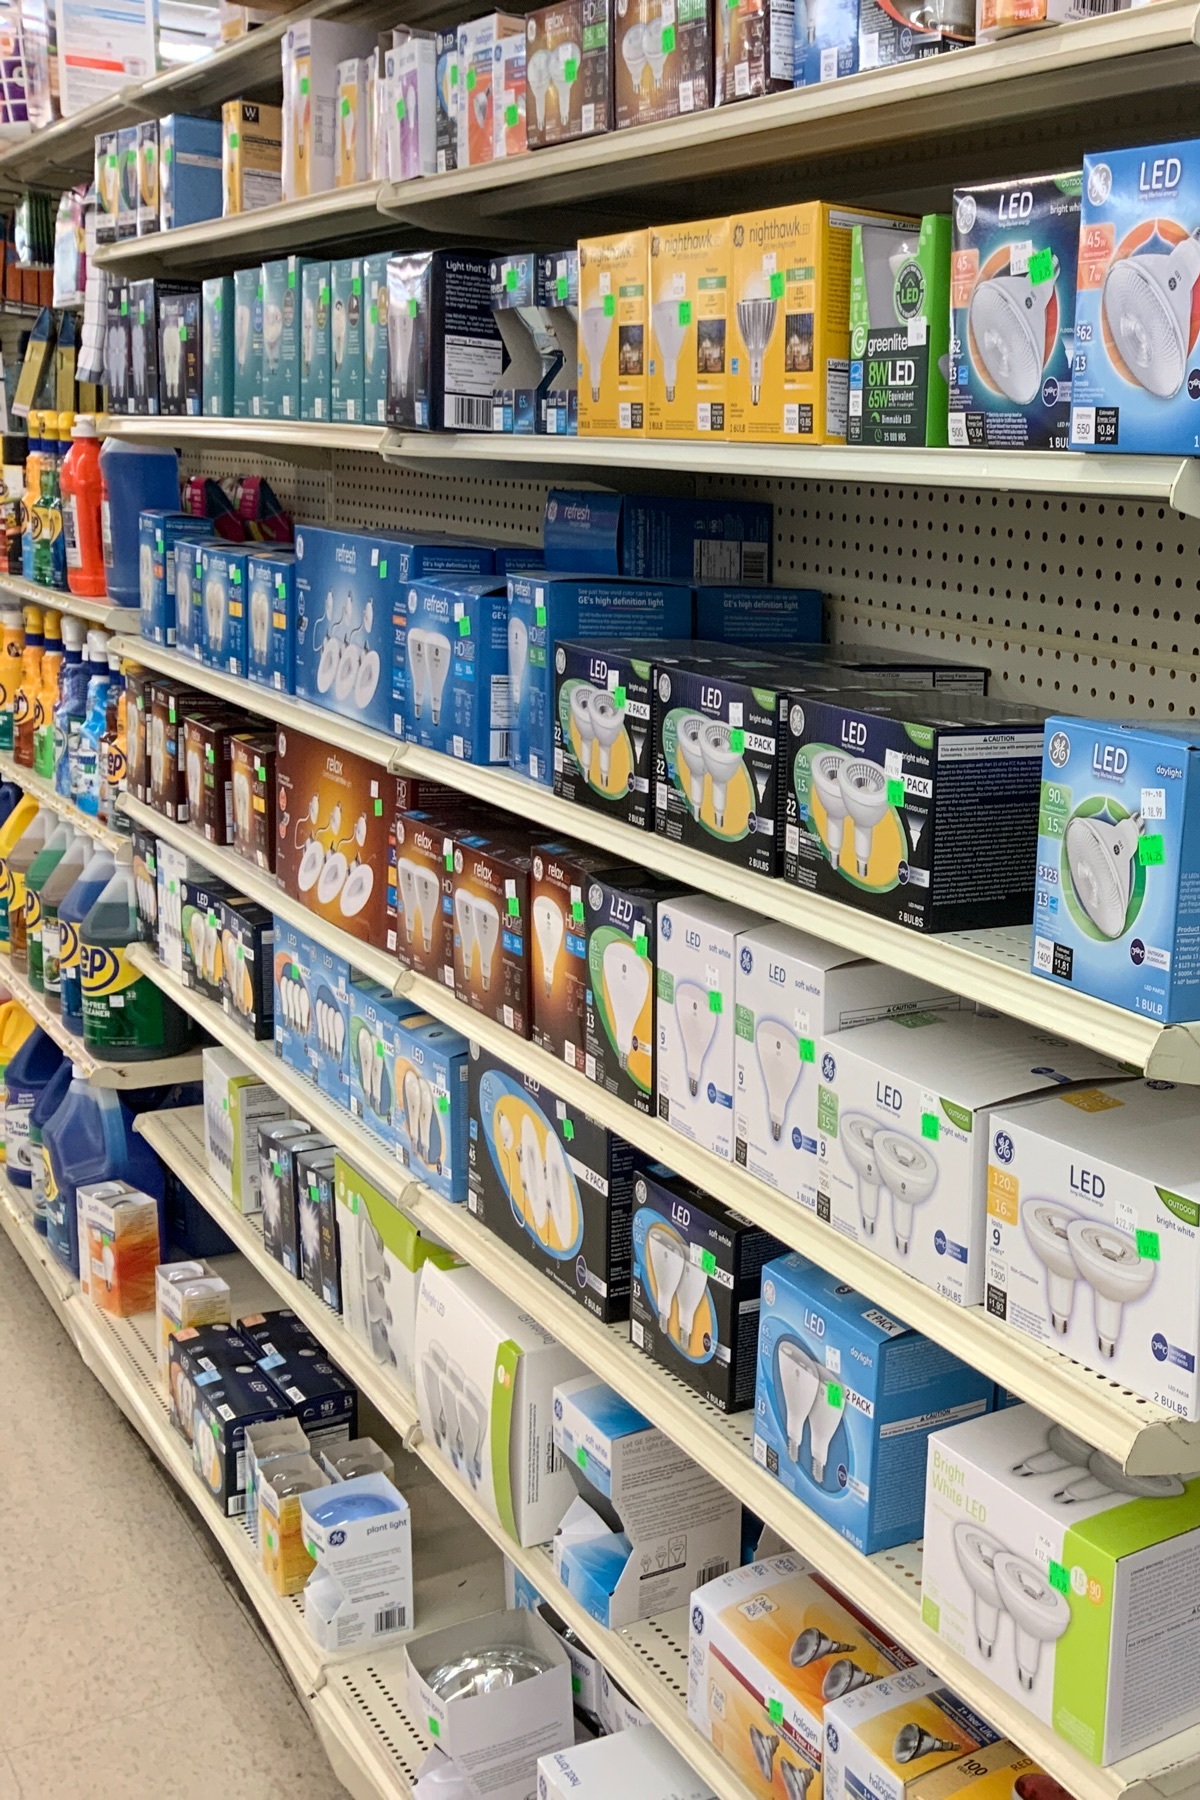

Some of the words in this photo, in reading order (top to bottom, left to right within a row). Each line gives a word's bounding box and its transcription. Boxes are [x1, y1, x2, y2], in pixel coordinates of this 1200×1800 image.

[1139, 159, 1181, 190] LED
[998, 192, 1033, 220] LED
[901, 289, 918, 303] LED
[868, 330, 908, 352] greenlite
[1076, 326, 1092, 340] $62
[1075, 356, 1085, 371] 13
[1076, 423, 1090, 434] 550
[1194, 436, 1199, 447] 1
[423, 596, 449, 615] refresh
[578, 598, 592, 606] GE's
[595, 598, 611, 607] high
[613, 598, 646, 607] definition
[648, 598, 664, 608] light
[842, 720, 867, 746] LED
[327, 755, 343, 775] relax
[1092, 743, 1128, 774] LED
[1156, 765, 1183, 779] daylight
[786, 799, 796, 815] 22
[414, 831, 433, 851] relax
[473, 861, 493, 883] relax
[1038, 867, 1058, 883] $123
[610, 894, 633, 923] LED
[768, 963, 786, 985] LED
[1142, 999, 1163, 1015] BULB
[876, 1081, 903, 1111] LED
[1070, 1163, 1105, 1199] LED
[1156, 1215, 1177, 1229] bright
[1177, 1223, 1195, 1238] white
[804, 1308, 825, 1337] LED
[850, 1346, 873, 1368] daylight
[846, 1390, 851, 1400] 2
[854, 1393, 872, 1414] PACK
[1154, 1391, 1159, 1402] 2
[1162, 1394, 1188, 1417] BULBS
[933, 1451, 966, 1485] Bright
[932, 1471, 962, 1510] White
[965, 1494, 987, 1524] LED
[366, 1521, 387, 1537] plant
[388, 1518, 407, 1532] light
[792, 1710, 819, 1744] halogen
[962, 1758, 988, 1776] 100
